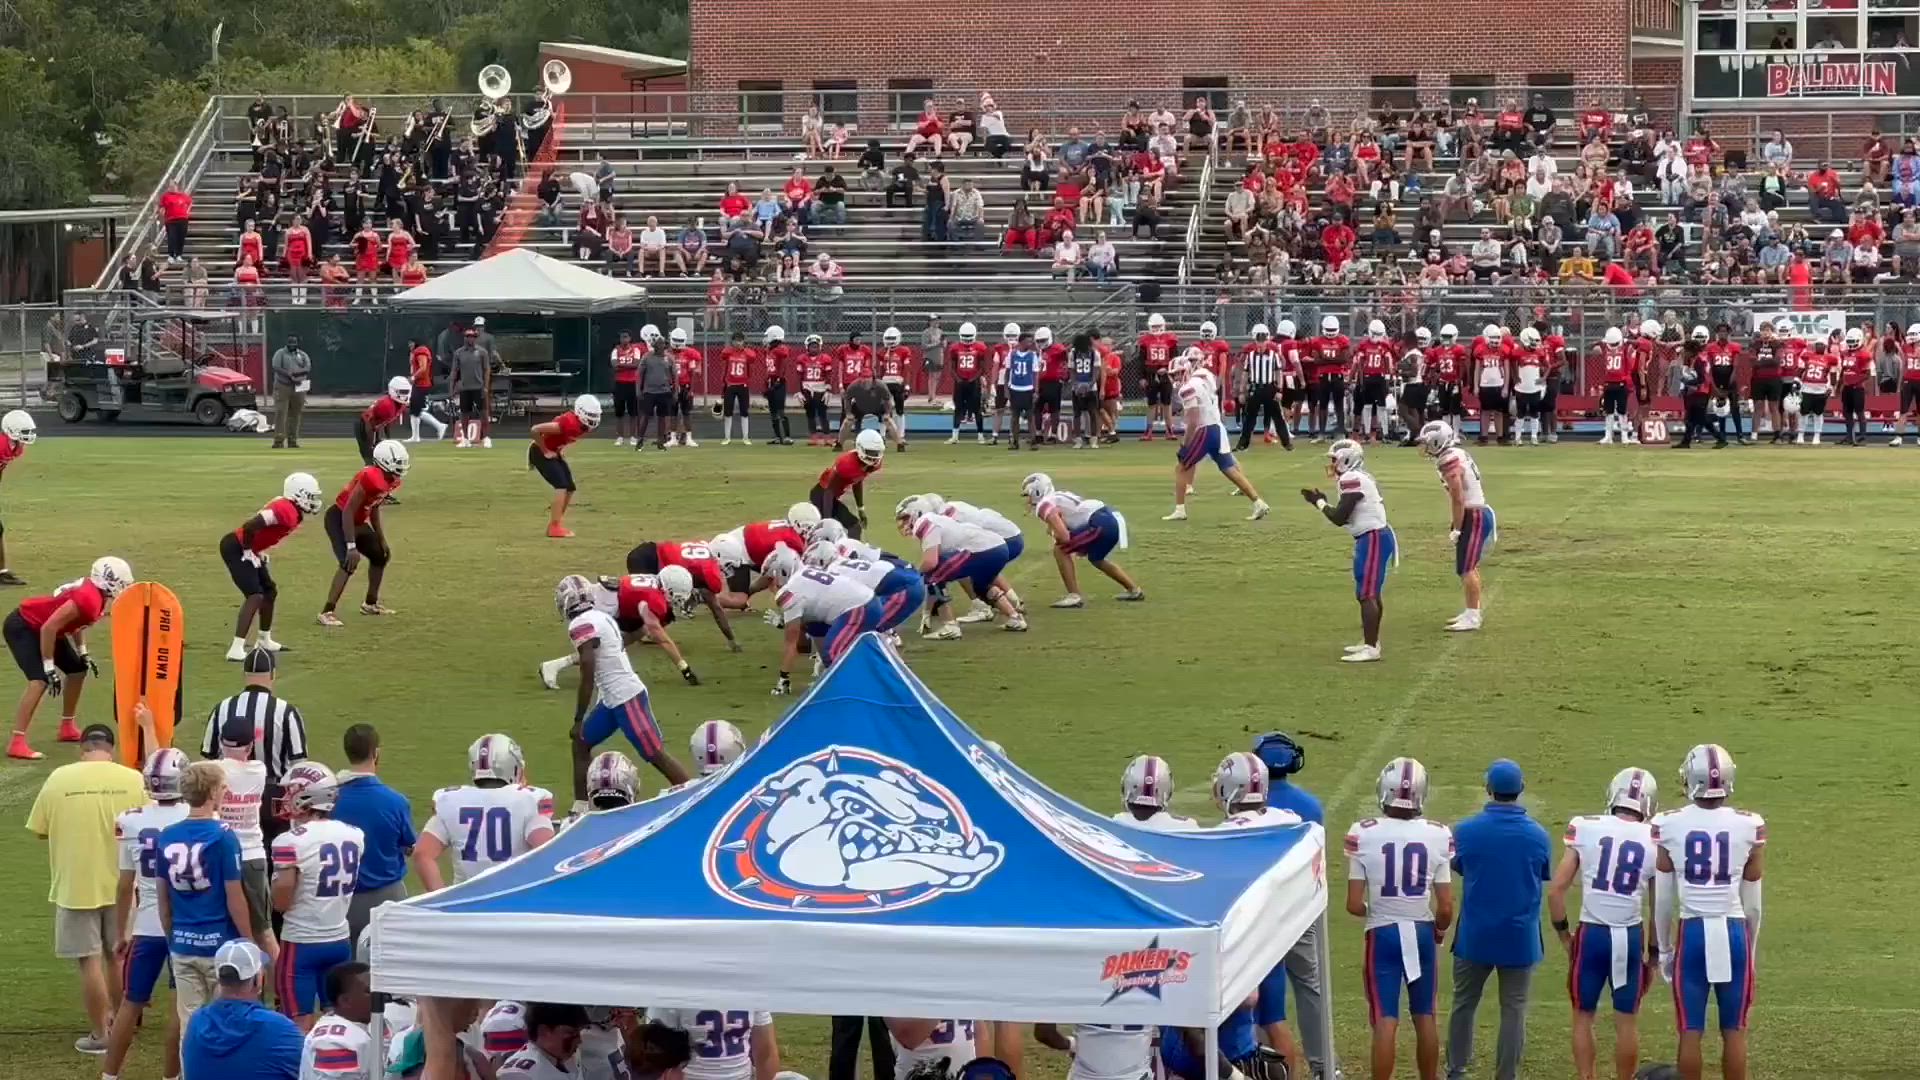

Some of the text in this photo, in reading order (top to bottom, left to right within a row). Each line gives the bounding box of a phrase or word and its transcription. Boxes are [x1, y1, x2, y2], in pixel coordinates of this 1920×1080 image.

[1767, 61, 1897, 96] BALDWIN
[730, 361, 745, 376] 16
[806, 368, 821, 379] 20
[846, 360, 862, 374] 24
[959, 355, 975, 369] 32
[1013, 361, 1027, 375] 31
[1076, 358, 1091, 373] 28
[1439, 358, 1453, 373] 23
[1606, 355, 1622, 370] 30
[1806, 364, 1823, 379] 25
[1644, 420, 1666, 441] 50
[156, 608, 172, 680] PRO DOWN
[459, 806, 512, 862] 70
[164, 842, 212, 891] 21
[316, 840, 359, 897] 29
[1380, 842, 1428, 897] 10
[1592, 835, 1646, 895] 18
[1684, 830, 1732, 886] 81
[1101, 949, 1192, 981] BAKER'S
[695, 1009, 751, 1058] 32
